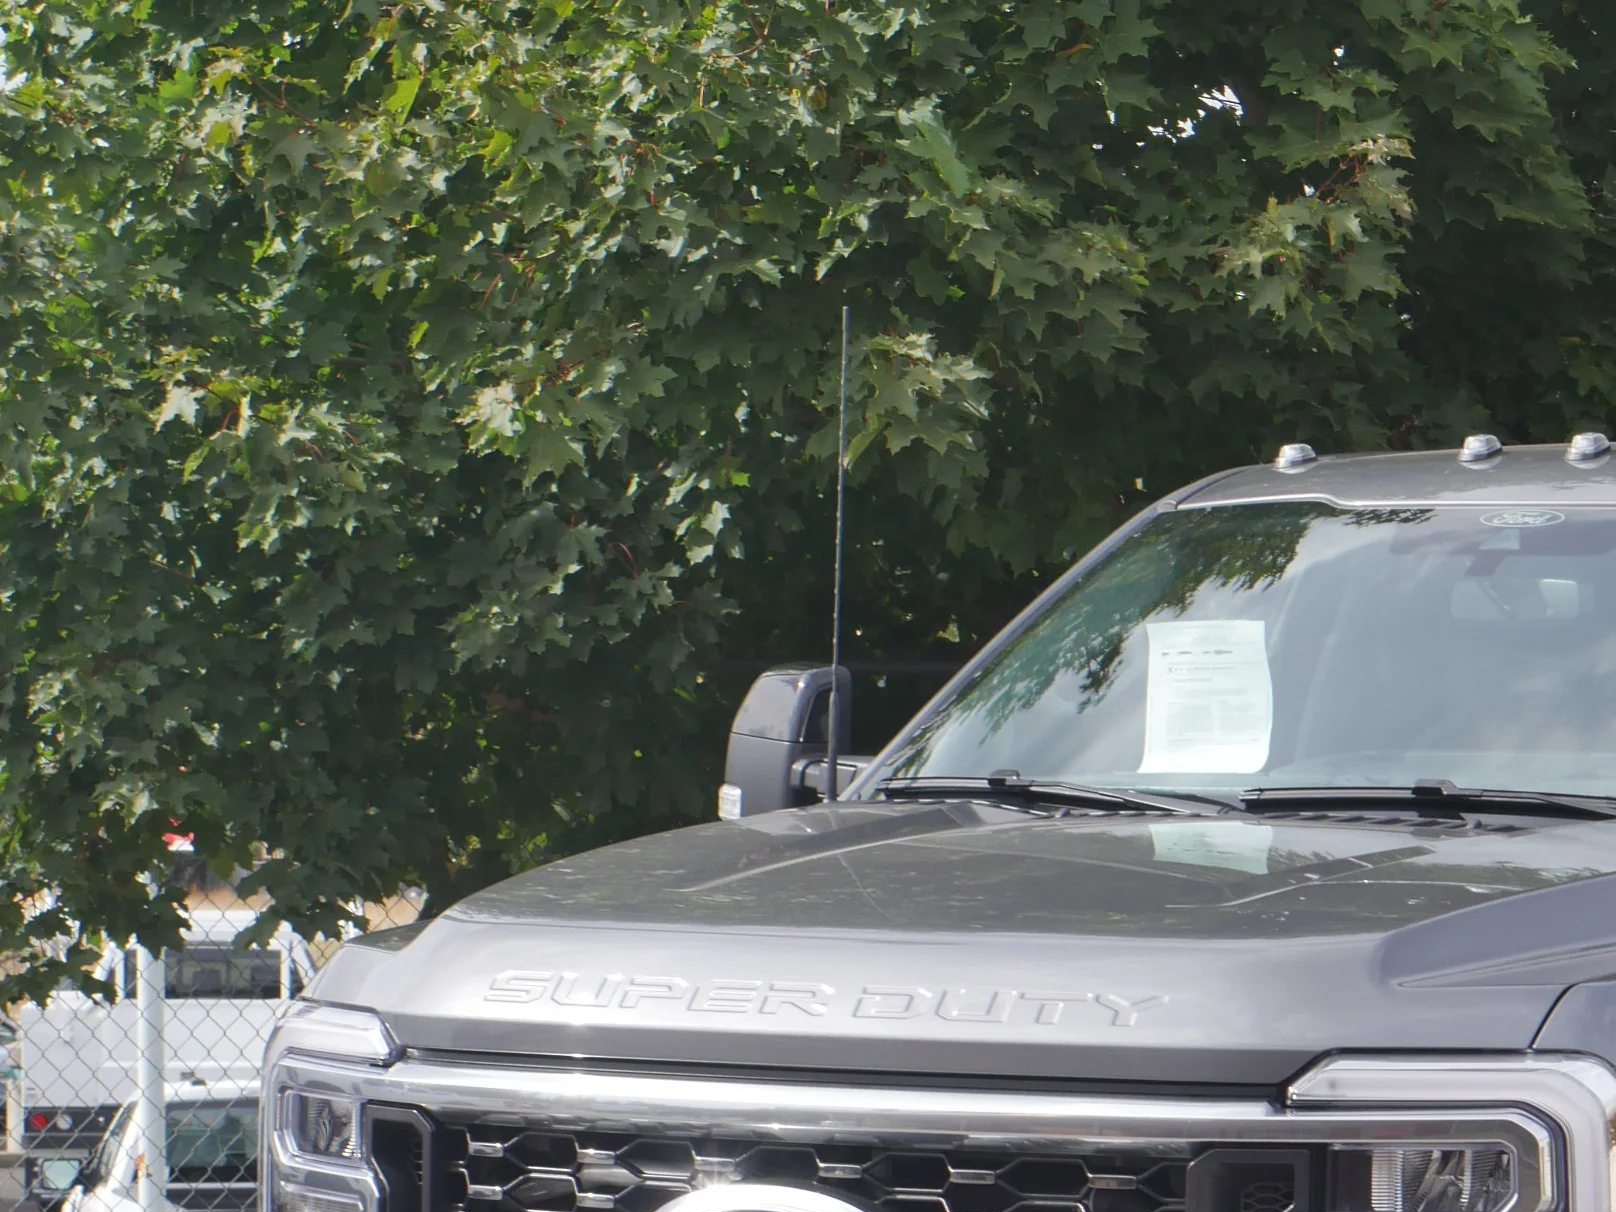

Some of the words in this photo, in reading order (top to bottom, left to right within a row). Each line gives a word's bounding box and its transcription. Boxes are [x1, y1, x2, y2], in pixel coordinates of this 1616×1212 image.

[1492, 511, 1551, 524] Ford
[484, 969, 837, 1018] SUPER
[851, 985, 1171, 1028] DUTY
